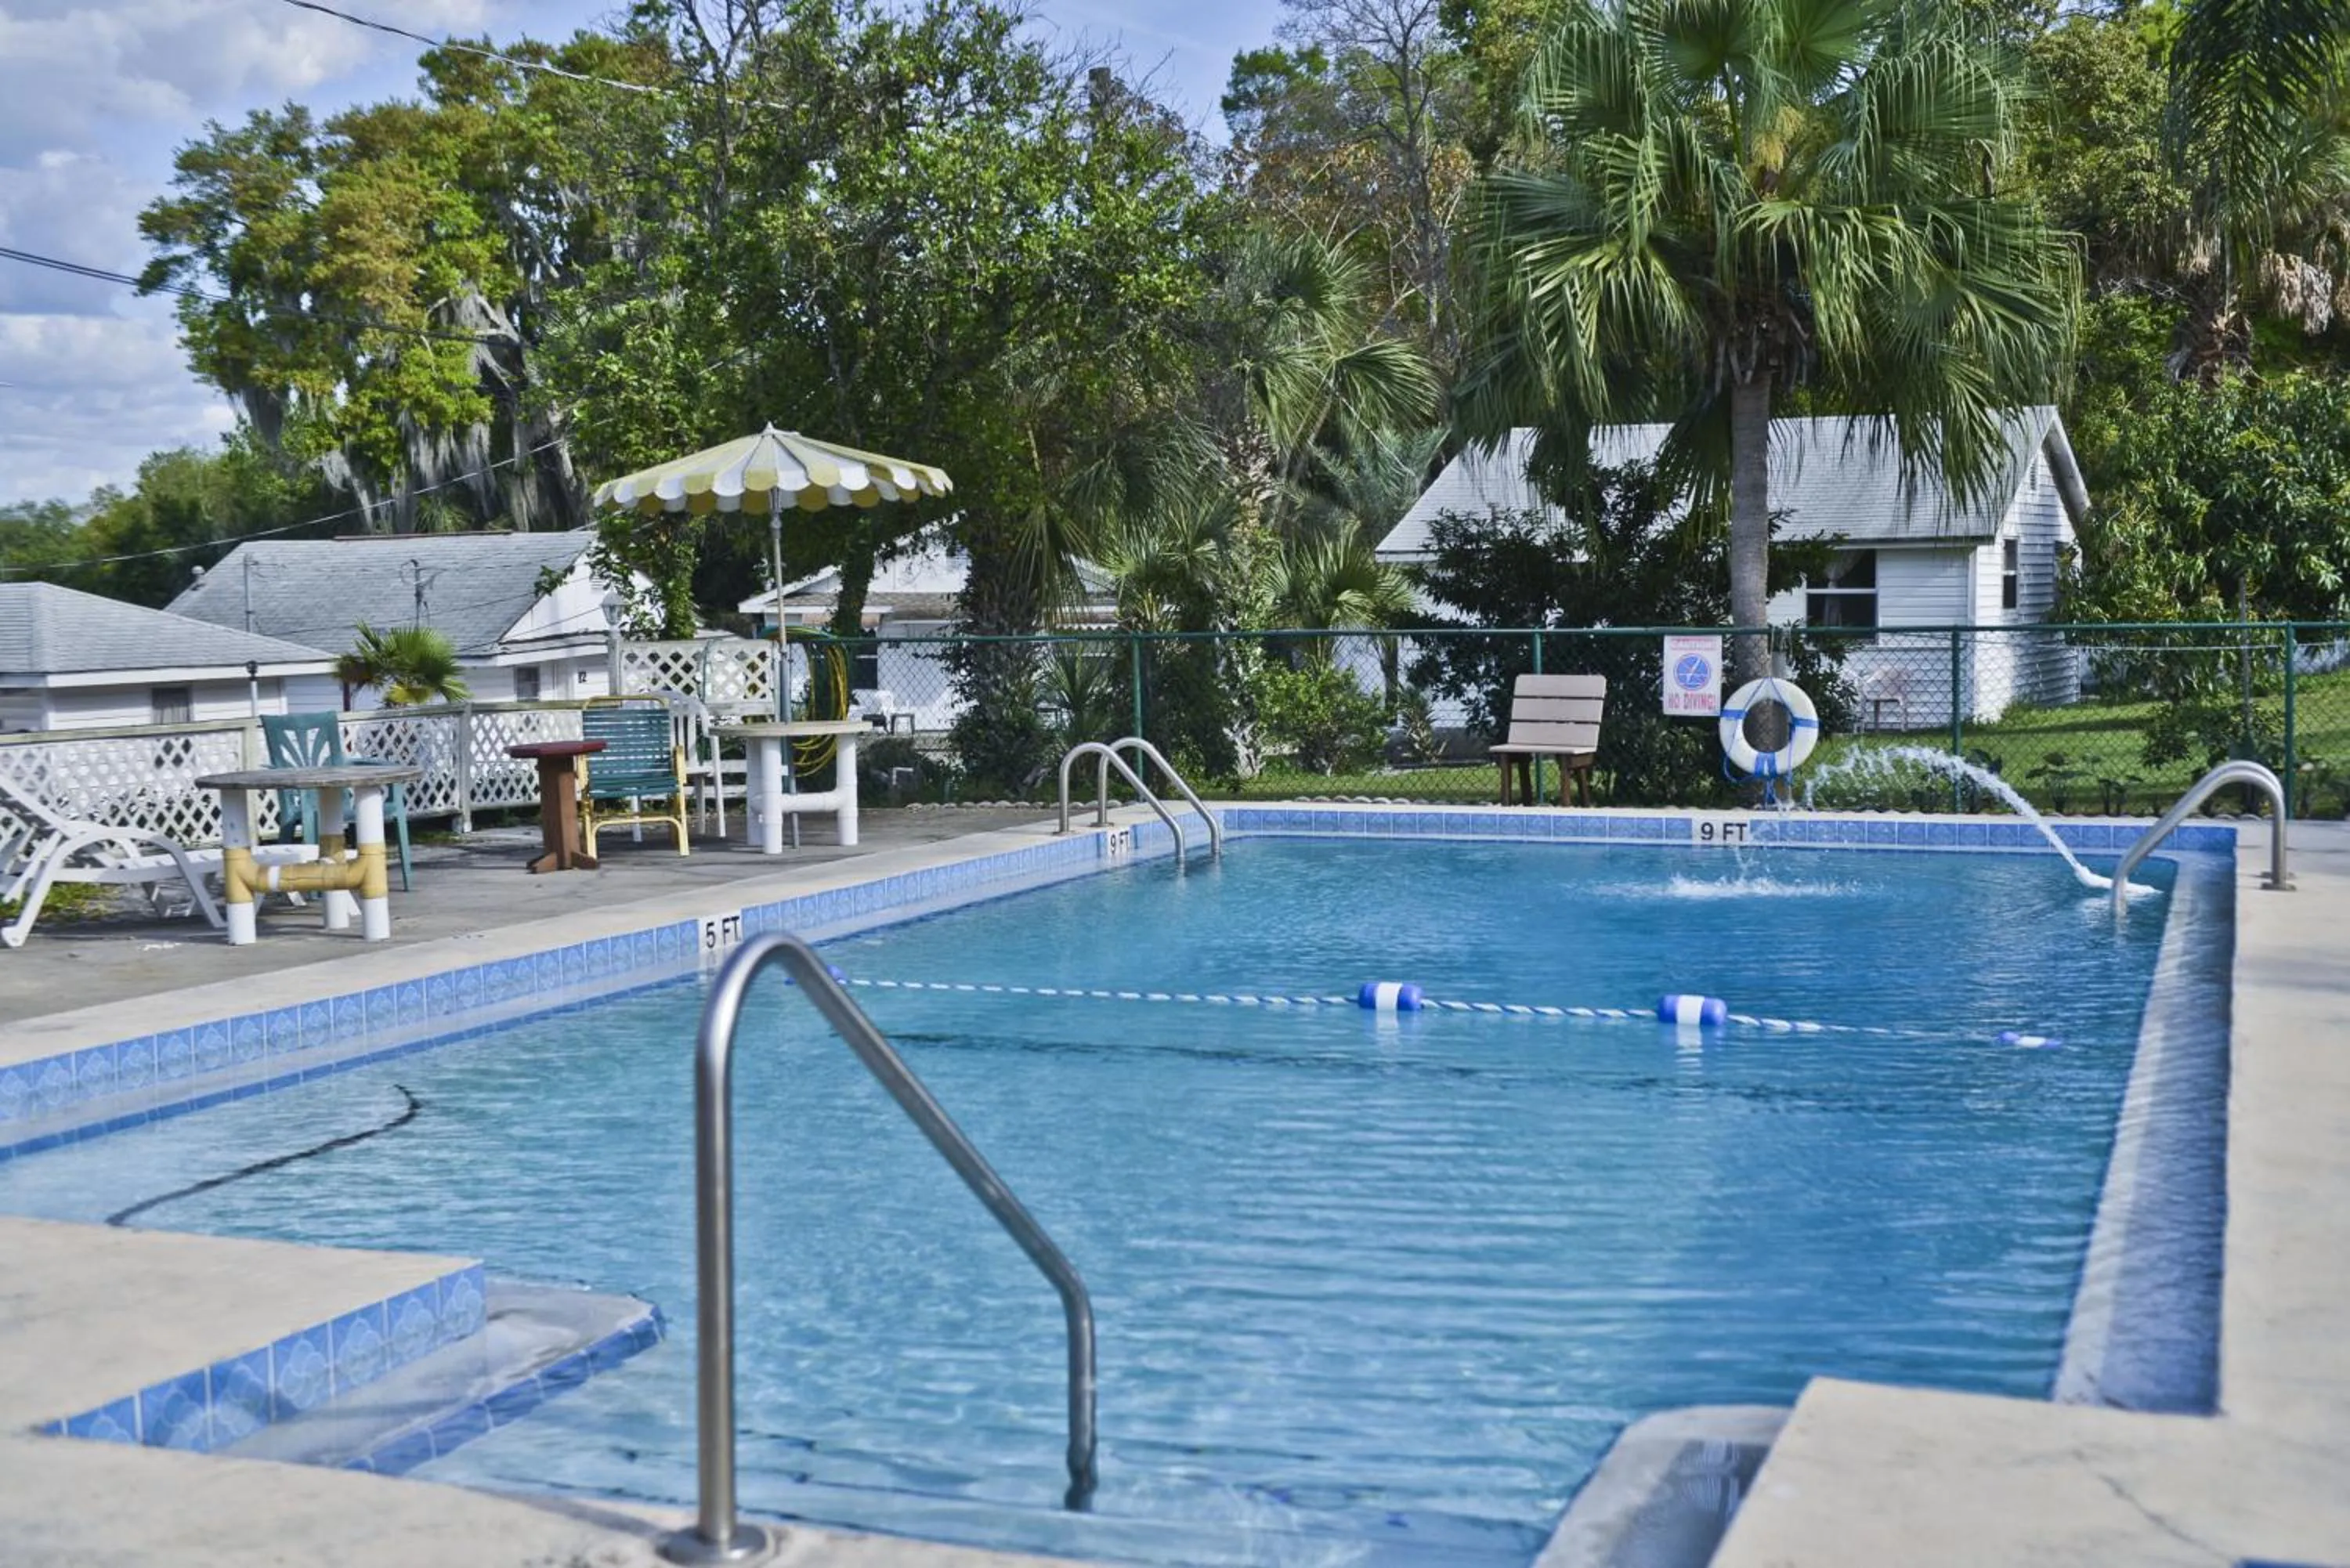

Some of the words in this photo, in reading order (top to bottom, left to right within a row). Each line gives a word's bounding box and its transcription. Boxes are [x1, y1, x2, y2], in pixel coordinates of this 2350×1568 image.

[1668, 692, 1680, 709] NO
[1701, 822, 1714, 840] 9
[1723, 822, 1748, 842] FT
[1110, 833, 1116, 855] 9
[706, 921, 716, 948] 5
[721, 916, 740, 945] FT
